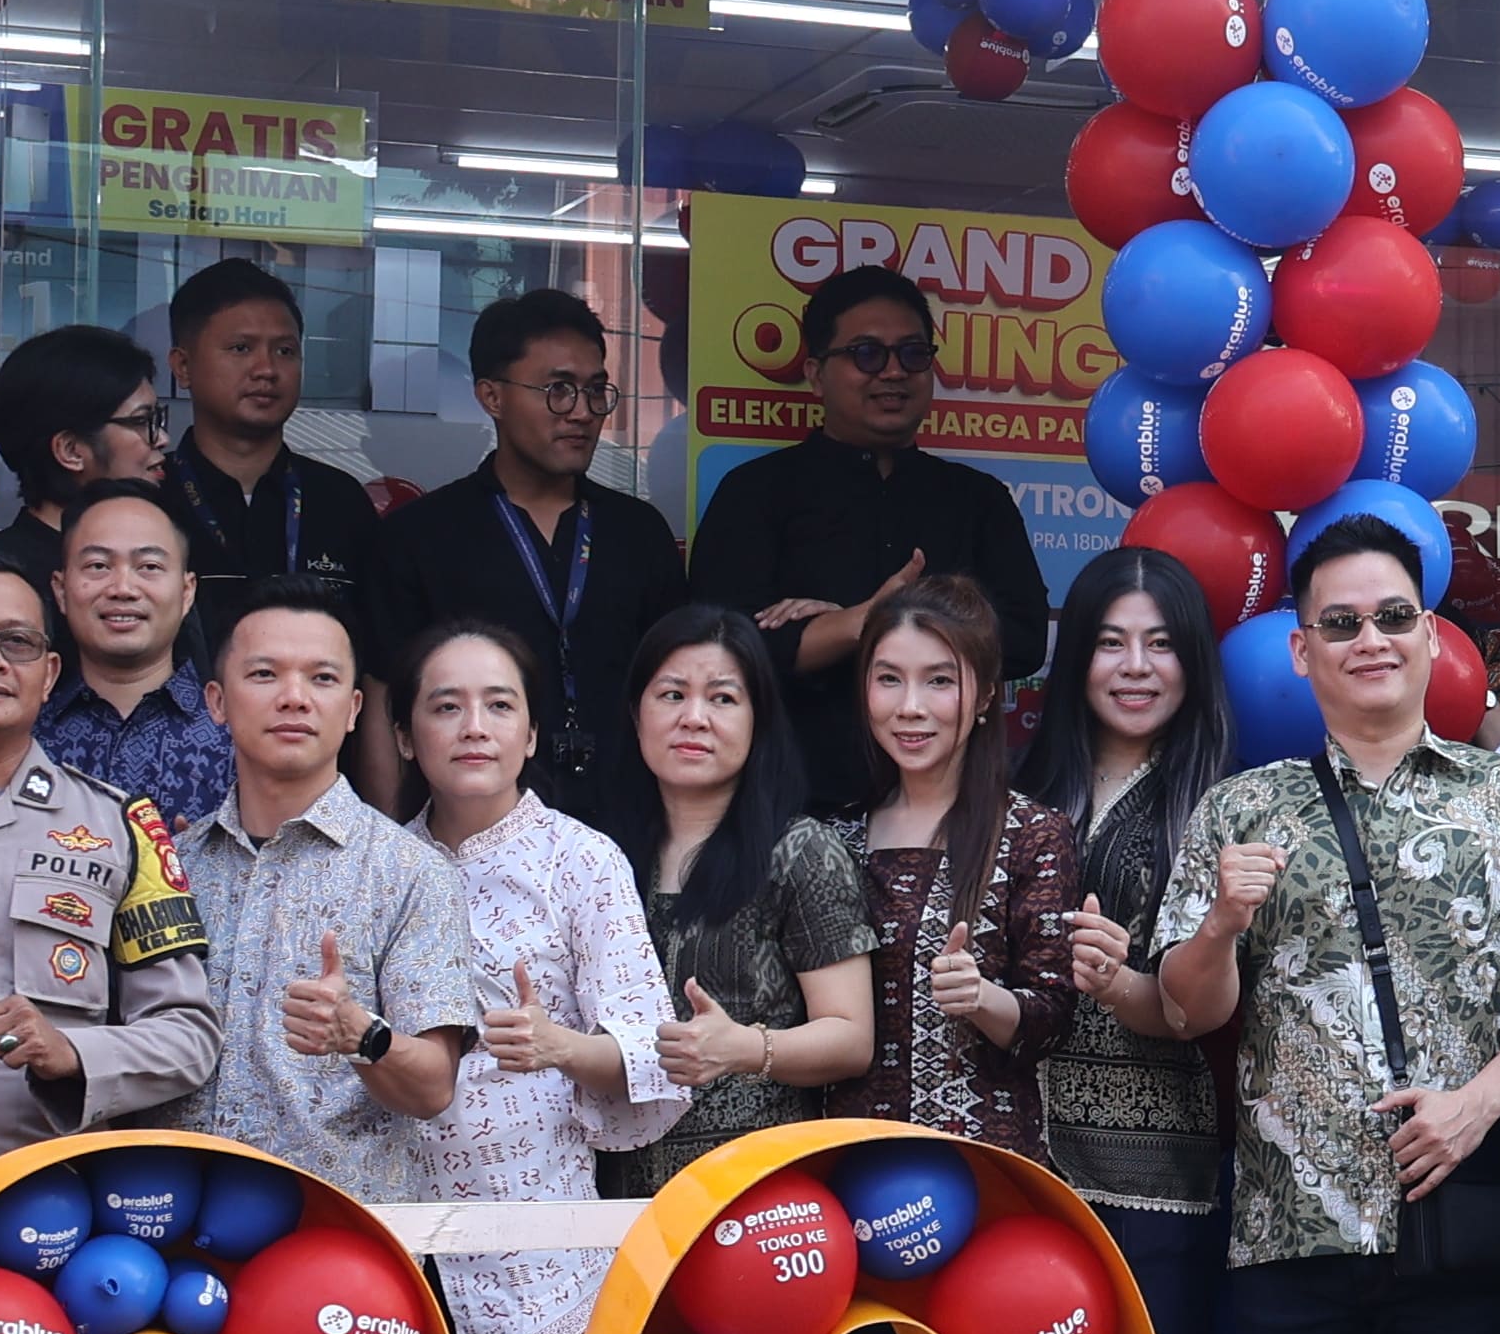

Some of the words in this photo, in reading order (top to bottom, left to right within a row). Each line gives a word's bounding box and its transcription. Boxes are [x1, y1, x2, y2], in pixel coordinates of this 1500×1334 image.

[101, 103, 338, 162] GRATIS
[100, 158, 338, 204] PENGIRIMAN
[148, 199, 231, 227] Setiap
[235, 205, 287, 227] Hari
[772, 217, 1092, 309] GRAND
[1218, 286, 1250, 364] erablue
[917, 413, 1030, 442] HARGA
[1033, 532, 1068, 550] PRA
[30, 853, 113, 887] POLRI
